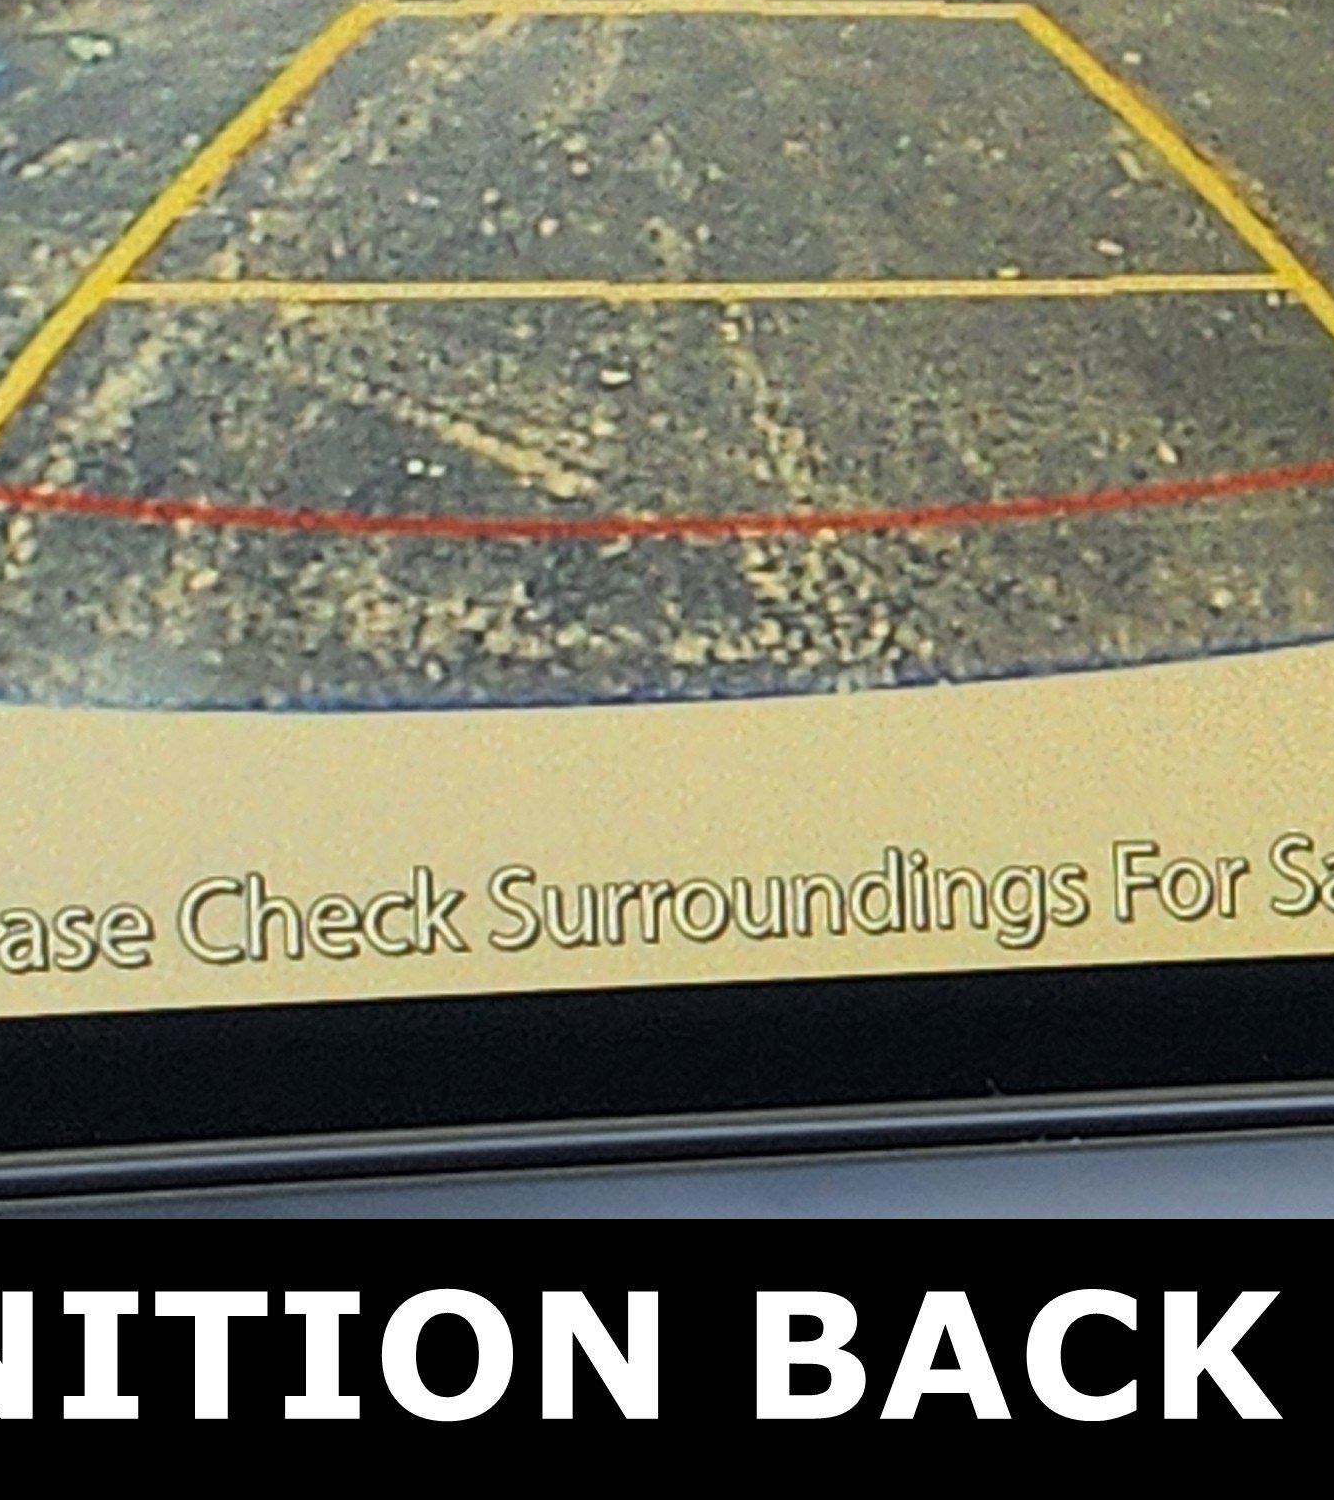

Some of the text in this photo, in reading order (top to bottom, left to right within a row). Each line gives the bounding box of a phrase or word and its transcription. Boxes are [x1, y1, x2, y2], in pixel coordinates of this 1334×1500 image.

[178, 866, 470, 964] Check
[487, 848, 1089, 949] Surroundings
[1111, 840, 1250, 923] For
